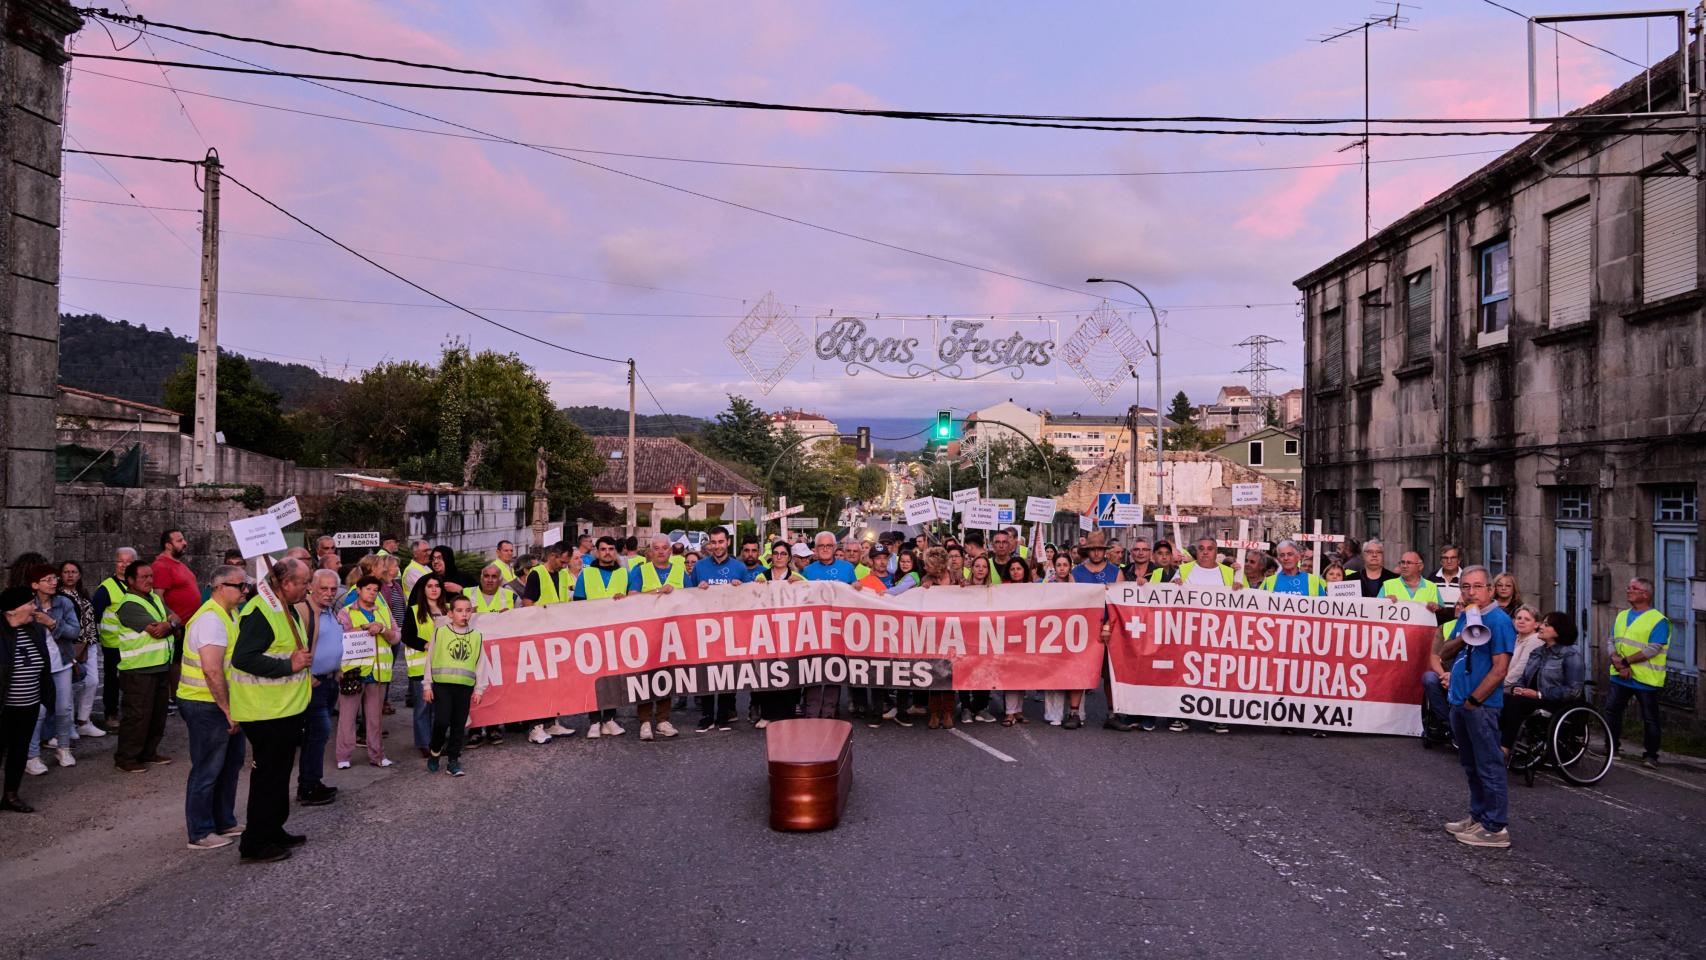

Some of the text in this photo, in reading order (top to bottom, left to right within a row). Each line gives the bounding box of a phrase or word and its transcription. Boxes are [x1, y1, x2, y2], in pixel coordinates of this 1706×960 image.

[815, 317, 1055, 366] Boas Festas
[276, 508, 297, 520] REGORIO
[909, 500, 930, 509] ACCESOS
[1224, 539, 1260, 549] N-120
[1123, 588, 1411, 621] PLATAFORMA NACIONAL 120
[481, 610, 1089, 687] N APOIO A PLATAFORMA N-120
[1154, 610, 1408, 662] INFRAESTRUTURA
[626, 656, 933, 702] NON MAIS MORTES
[1183, 650, 1368, 699] SEPULTURAS
[1179, 694, 1353, 727] SOLUCIÓN XA!
